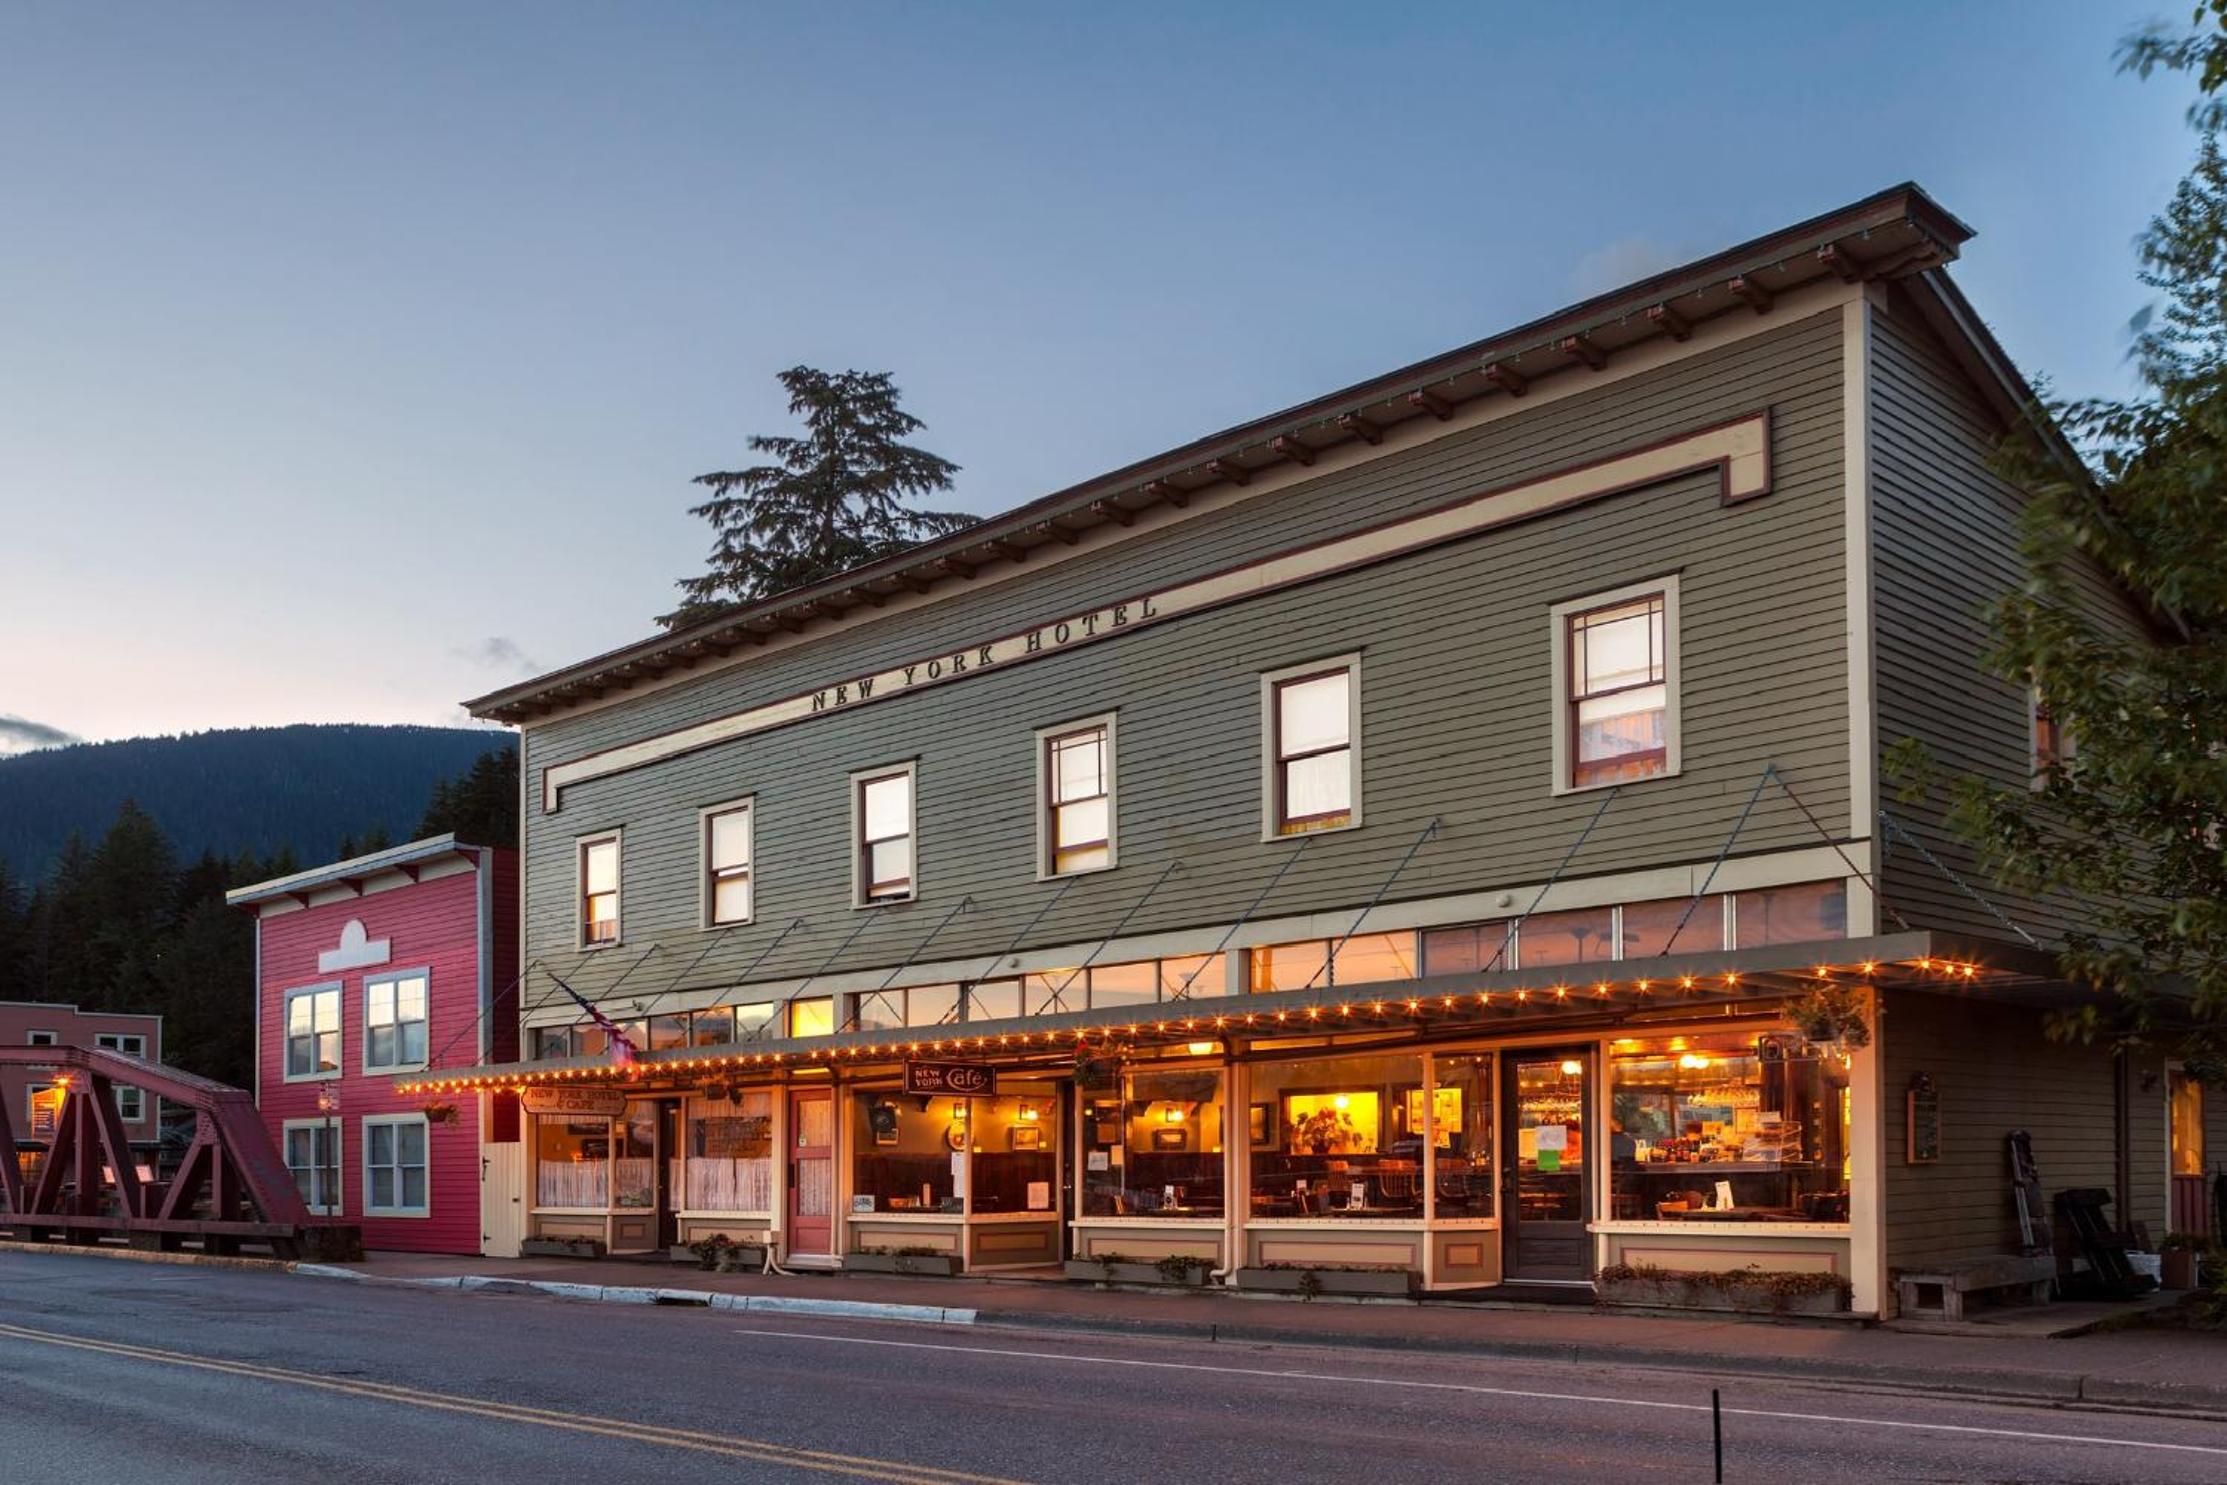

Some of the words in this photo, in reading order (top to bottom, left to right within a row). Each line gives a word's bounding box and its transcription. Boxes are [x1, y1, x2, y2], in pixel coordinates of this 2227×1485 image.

[811, 678, 875, 712] NEW
[903, 645, 995, 686] YORK
[1025, 599, 1157, 654] HOTEL
[915, 1069, 940, 1078] NEW
[915, 1078, 943, 1087] YORK
[530, 1089, 553, 1098] NEW
